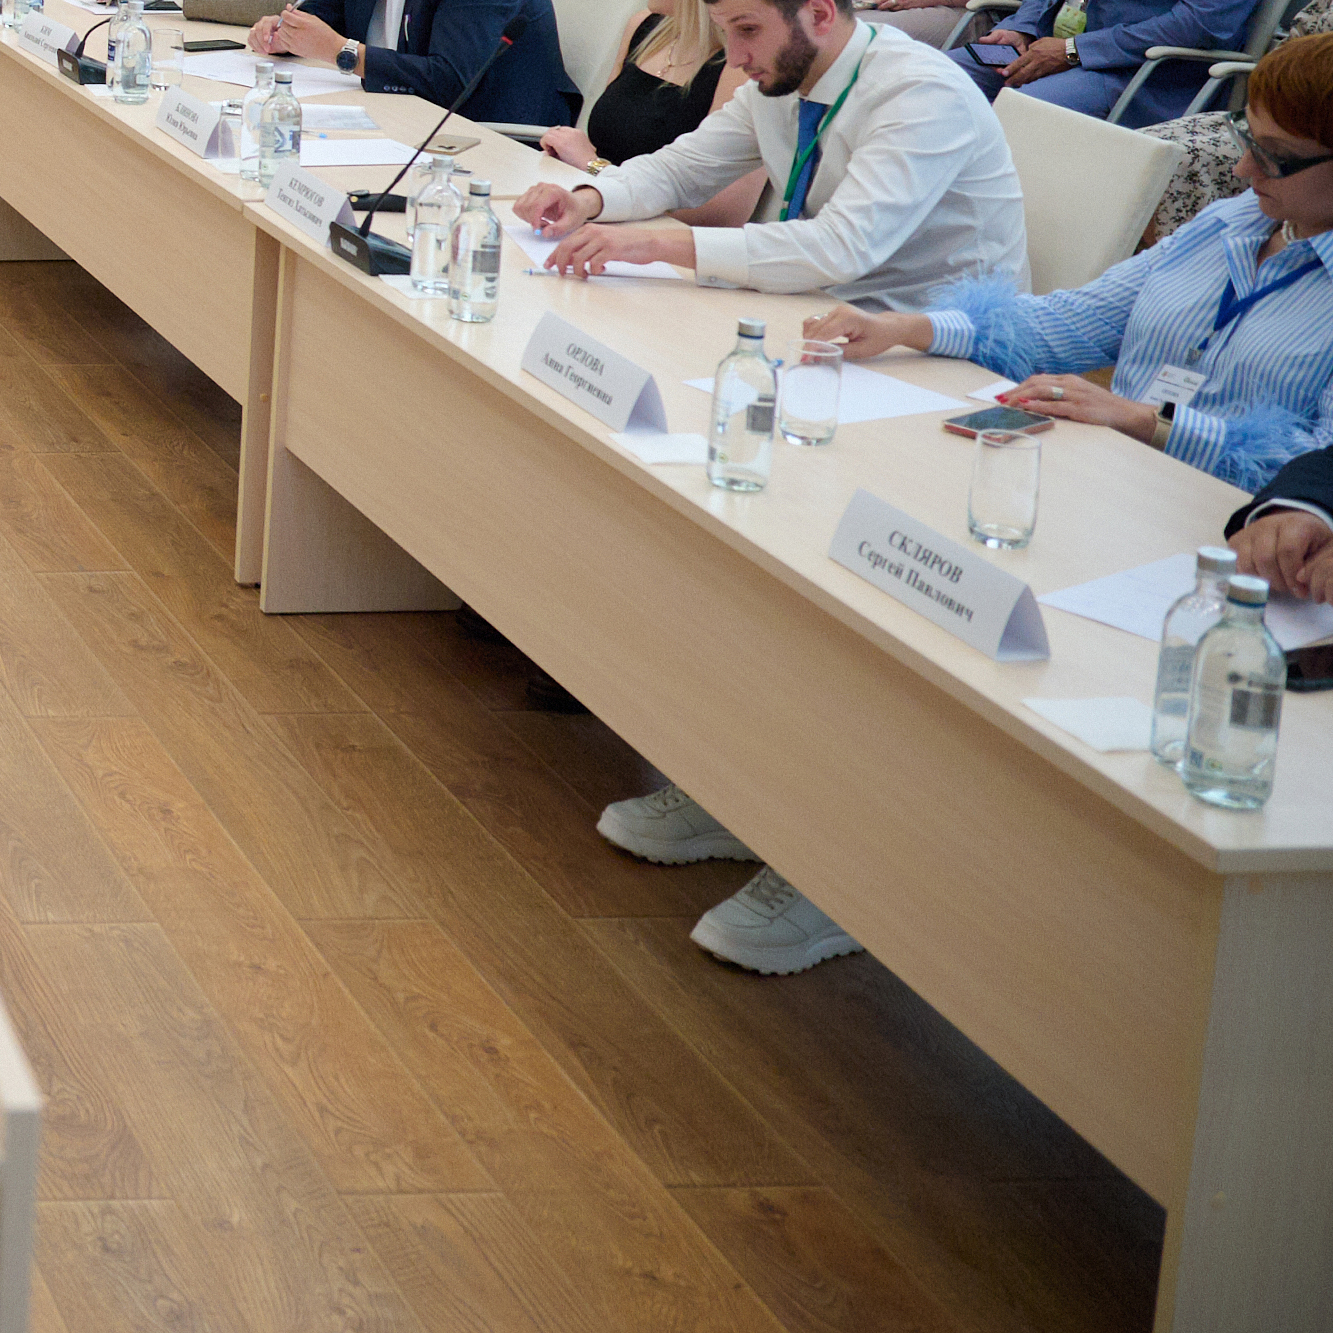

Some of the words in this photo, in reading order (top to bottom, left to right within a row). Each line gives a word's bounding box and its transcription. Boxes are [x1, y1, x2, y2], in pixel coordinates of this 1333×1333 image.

[542, 352, 564, 374] Анна
[564, 365, 613, 406] Георгиевна
[566, 343, 605, 376] ОРЛОВА
[858, 541, 903, 580] Сергей
[906, 569, 974, 622] Павлович
[888, 530, 964, 584] СКЛЯРОВ
